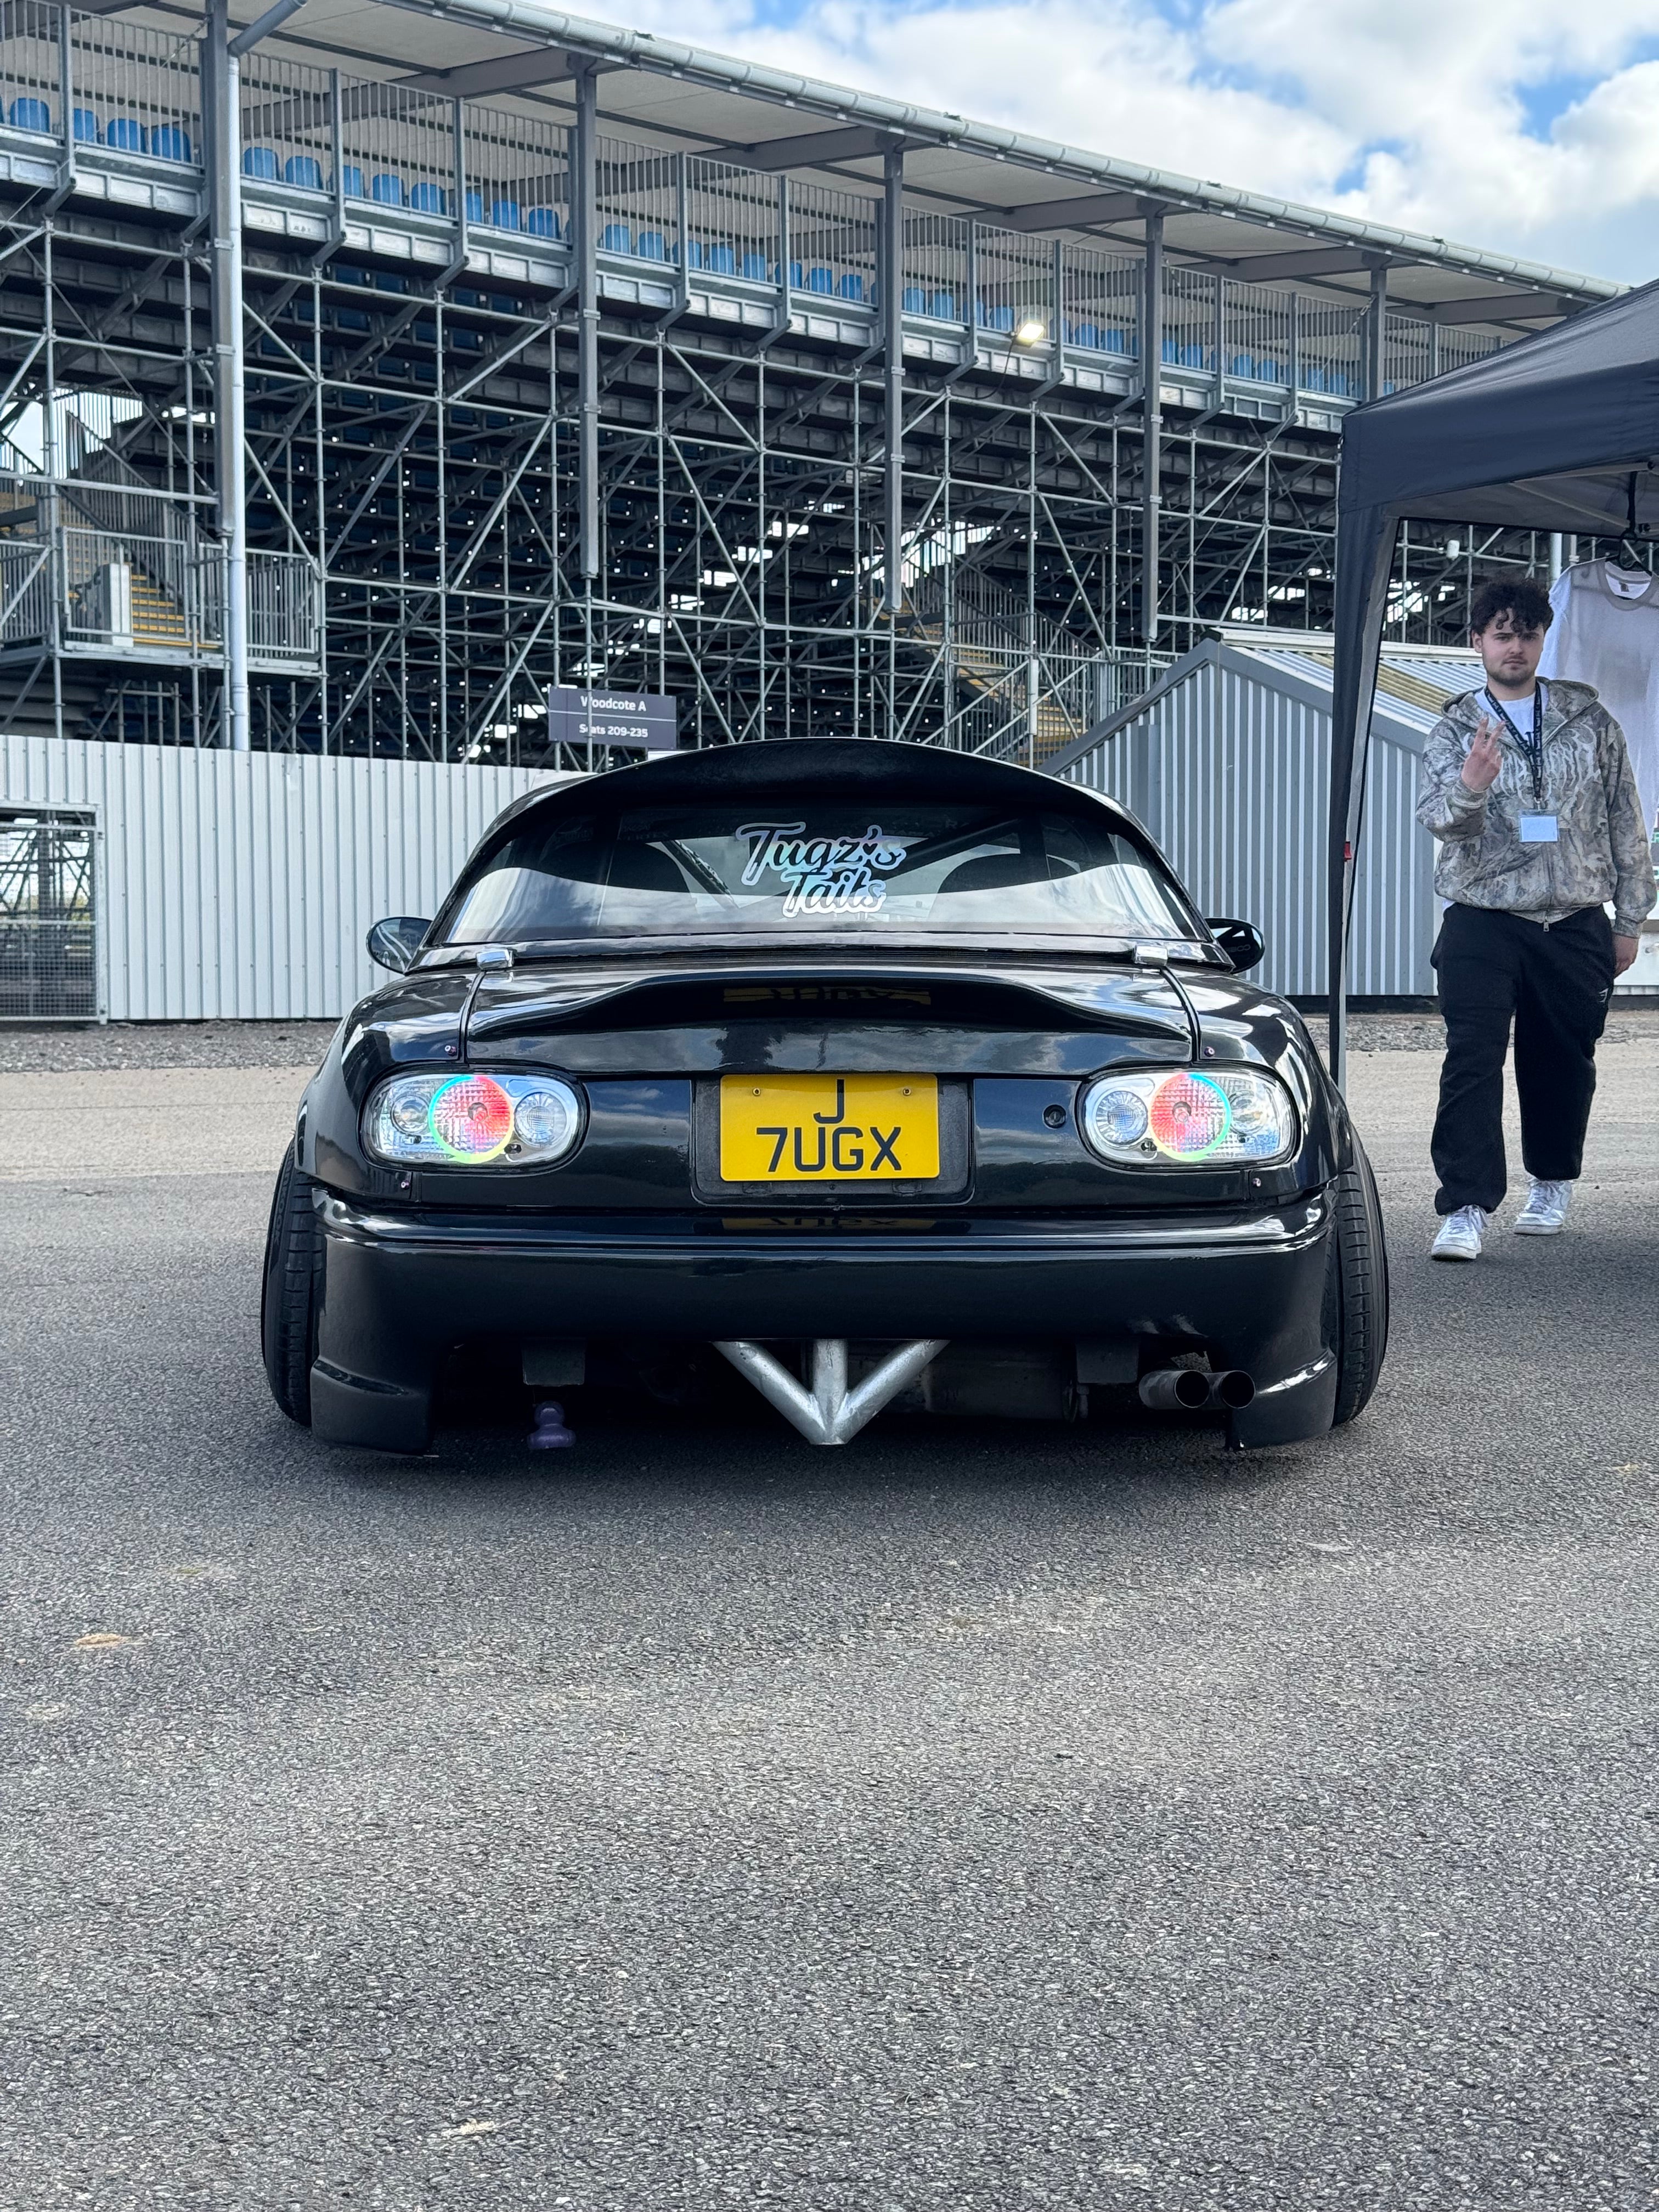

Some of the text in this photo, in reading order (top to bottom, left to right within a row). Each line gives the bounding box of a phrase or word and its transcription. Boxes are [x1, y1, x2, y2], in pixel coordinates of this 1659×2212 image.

[637, 701, 647, 712] A
[579, 724, 648, 738] Sats 209-235
[780, 866, 887, 918] Tails
[814, 1079, 844, 1124] J
[757, 1127, 901, 1172] 7UGX
